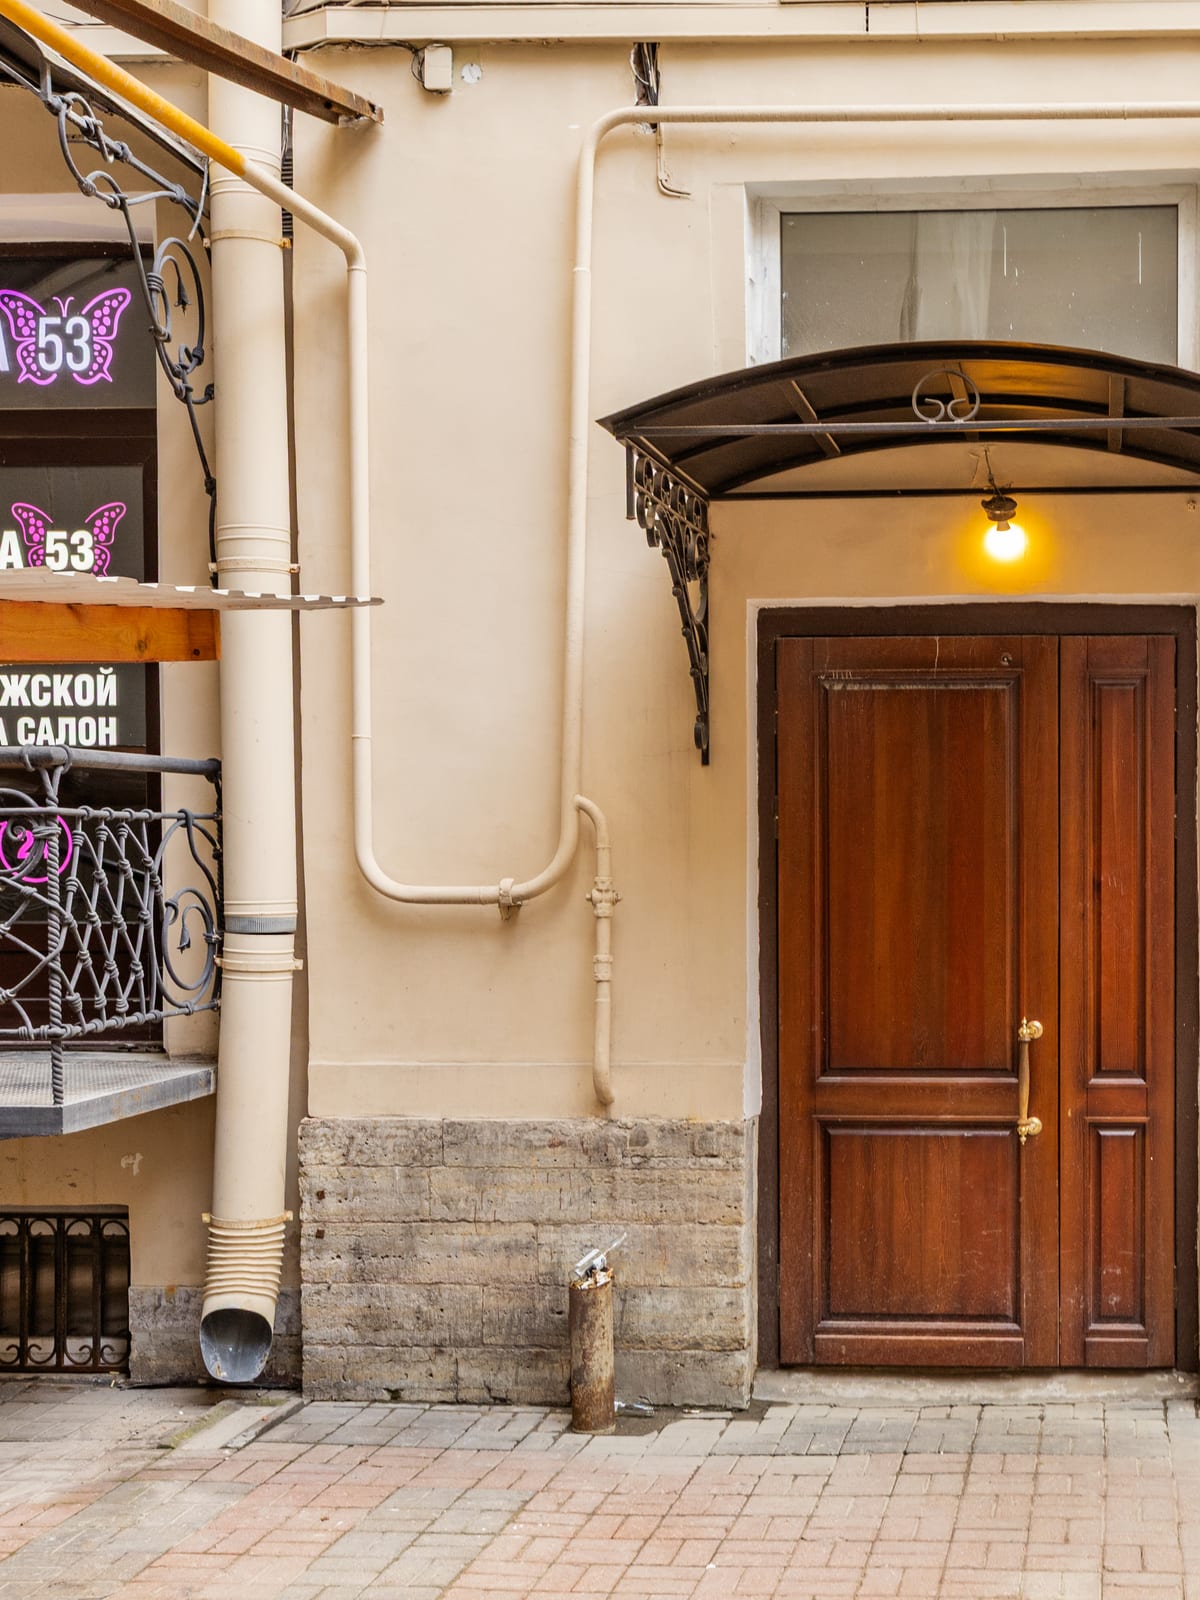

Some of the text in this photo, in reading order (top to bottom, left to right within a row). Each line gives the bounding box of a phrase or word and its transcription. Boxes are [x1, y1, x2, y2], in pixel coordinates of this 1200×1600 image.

[38, 316, 91, 371] 53
[45, 529, 94, 571] 53
[17, 716, 117, 747] САЛОН
